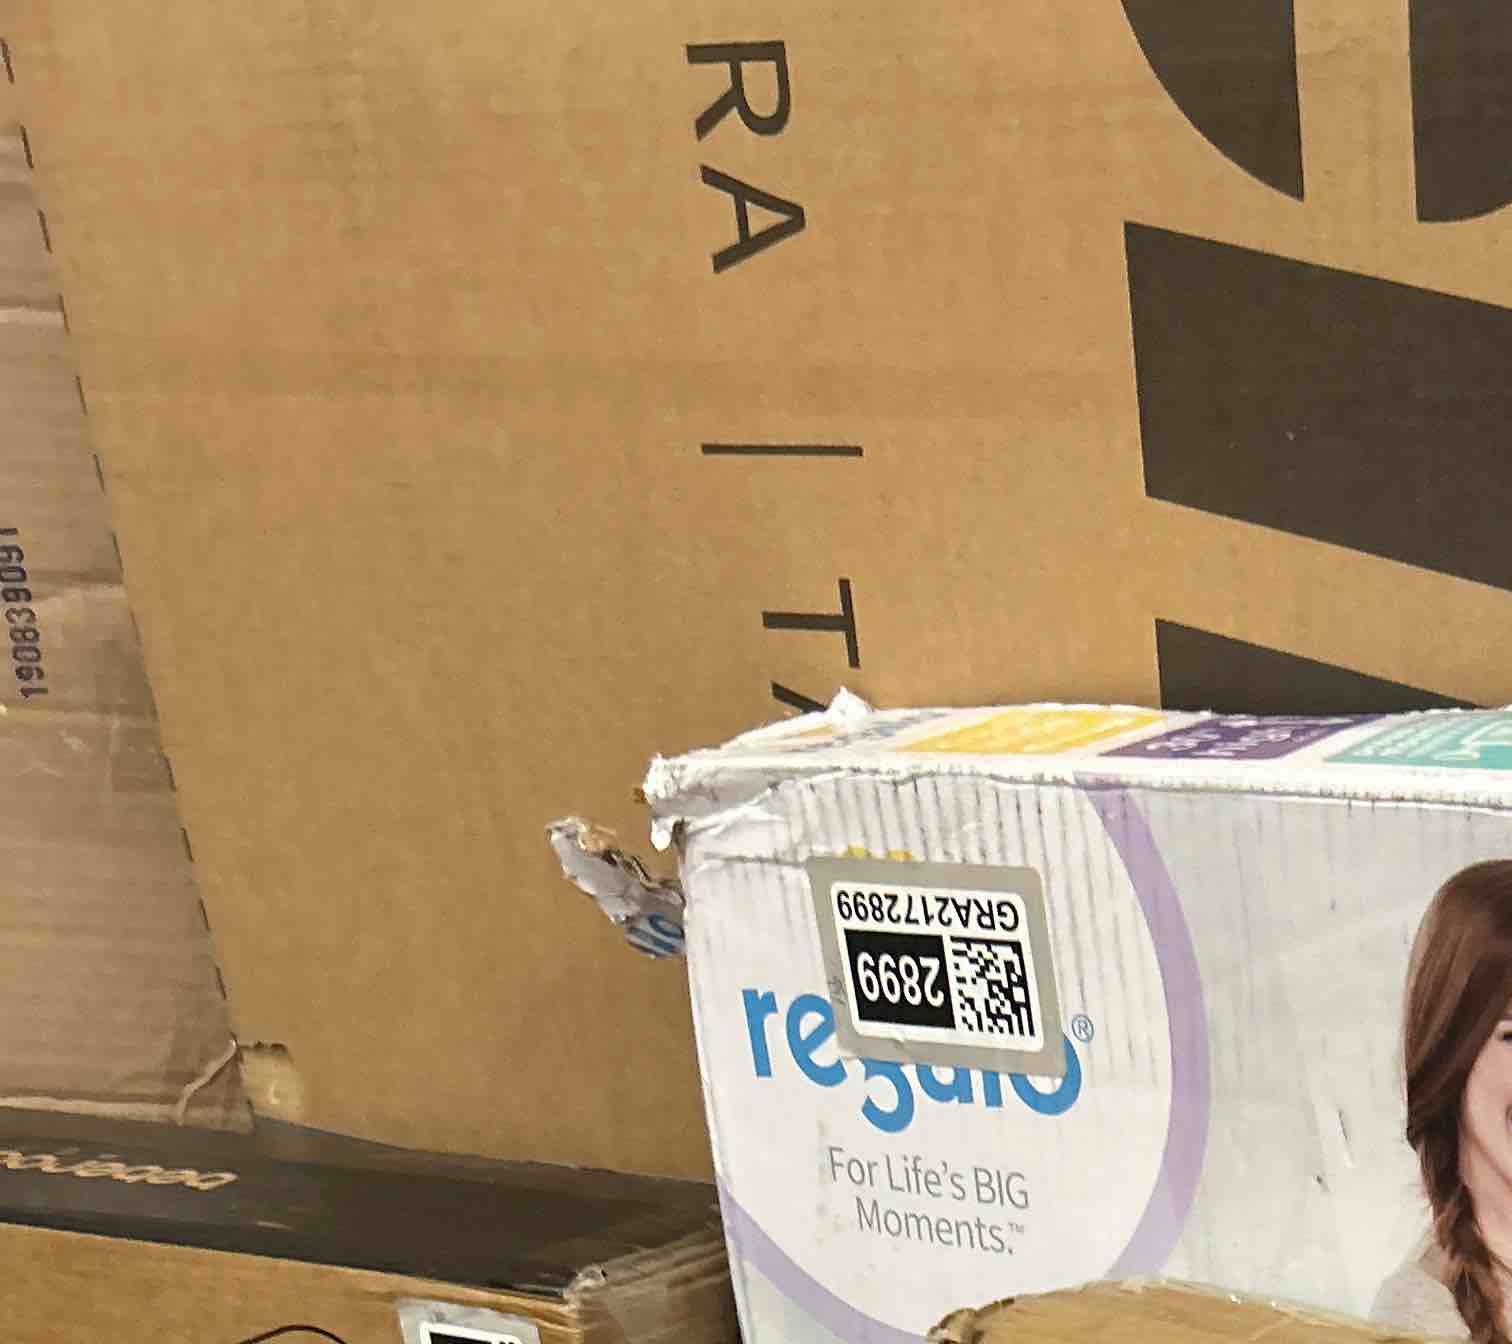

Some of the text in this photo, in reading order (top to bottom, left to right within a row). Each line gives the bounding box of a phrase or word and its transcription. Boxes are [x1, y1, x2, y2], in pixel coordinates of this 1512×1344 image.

[836, 888, 1020, 932] GRA2172899
[855, 951, 946, 1008] 2899
[828, 1146, 879, 1185] For
[973, 1168, 1030, 1209] BIG
